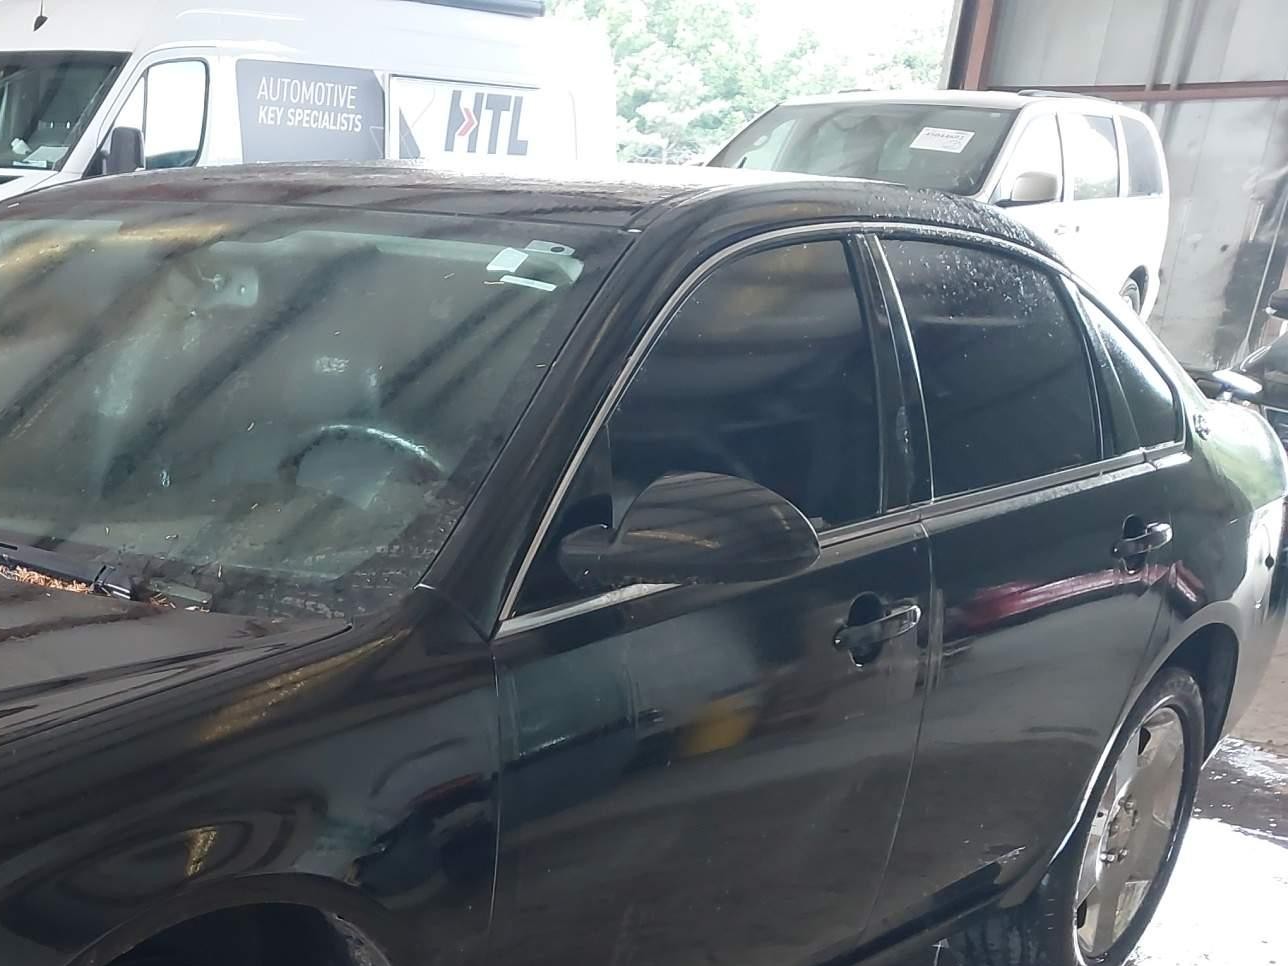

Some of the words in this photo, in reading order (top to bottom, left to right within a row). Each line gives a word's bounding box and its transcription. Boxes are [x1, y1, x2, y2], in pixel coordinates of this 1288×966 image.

[257, 75, 358, 110] AUTOMOTIVE
[257, 106, 284, 127] KEY
[286, 107, 363, 133] SPECIALISTS
[443, 89, 530, 157] HTL
